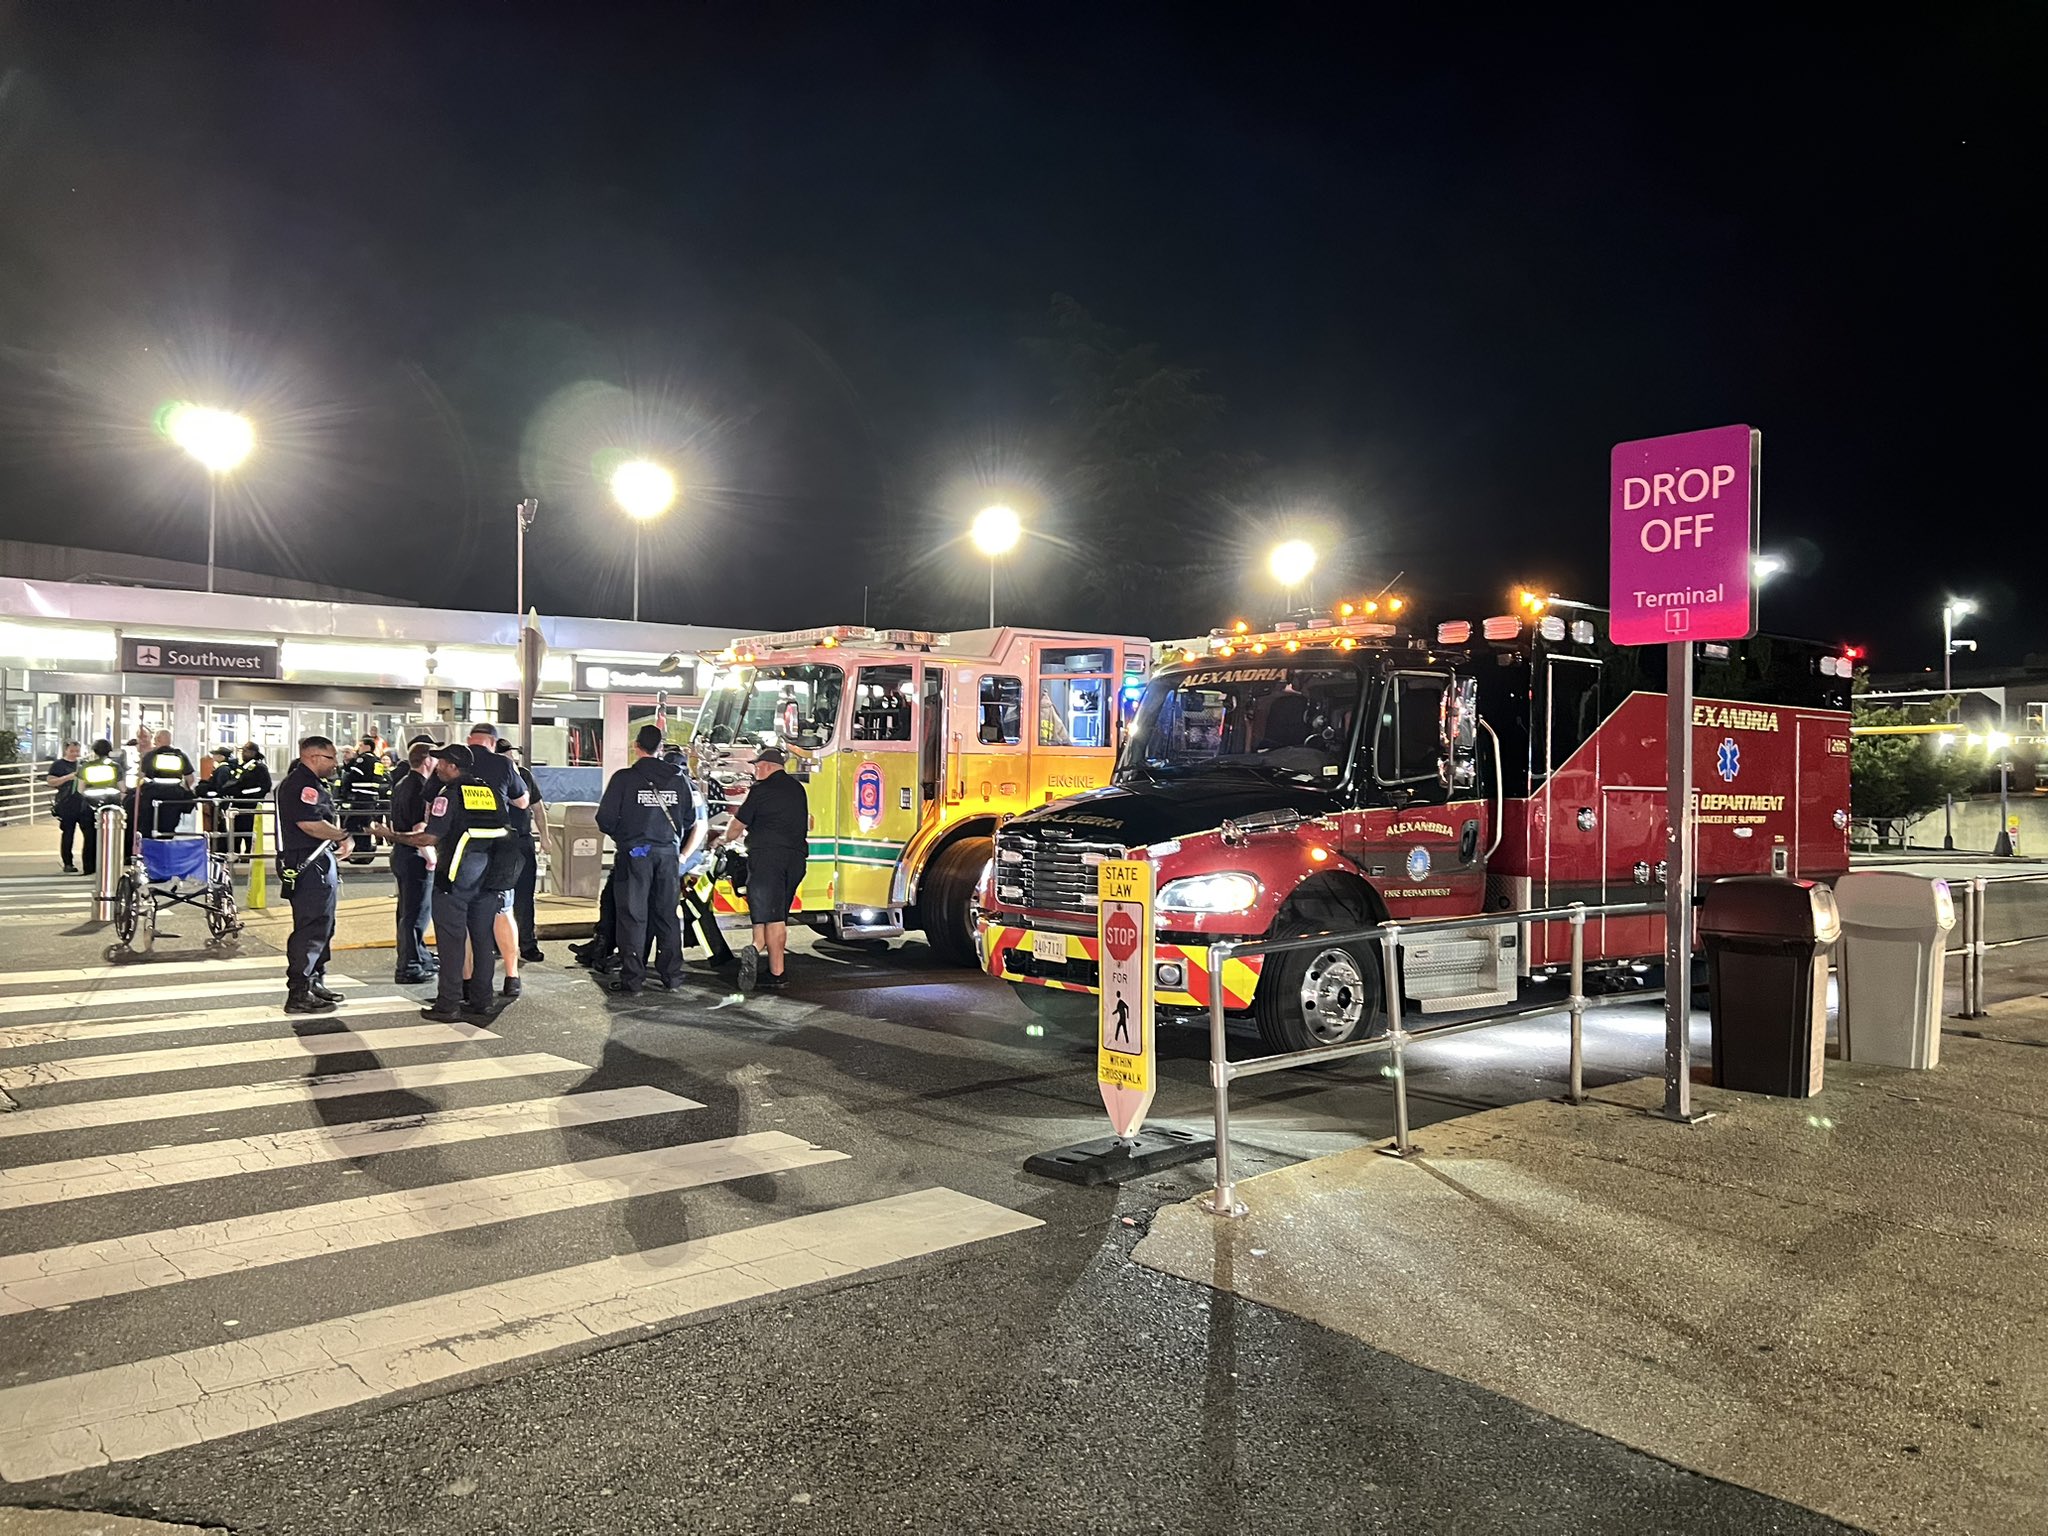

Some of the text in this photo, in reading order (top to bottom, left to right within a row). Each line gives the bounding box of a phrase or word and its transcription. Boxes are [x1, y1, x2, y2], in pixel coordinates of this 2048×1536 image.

[1624, 465, 1735, 510] DROP
[1641, 514, 1714, 552] OFF
[1633, 583, 1724, 607] Terminal
[1673, 612, 1681, 628] 1
[168, 651, 261, 668] Southwest
[1179, 668, 1288, 687] ALEXANDRIA
[1692, 705, 1778, 731] EXANDRIA
[1048, 775, 1094, 788] ENGINE
[464, 789, 492, 798] MWAA
[1701, 794, 1785, 811] DEPARTMENT
[1386, 821, 1453, 837] ALEXANDRIA
[1106, 867, 1138, 881] STATE
[1110, 885, 1132, 897] LAW
[1107, 927, 1136, 946] STOP
[1112, 972, 1128, 984] FOR
[1101, 1066, 1141, 1085] CROSSWALK
